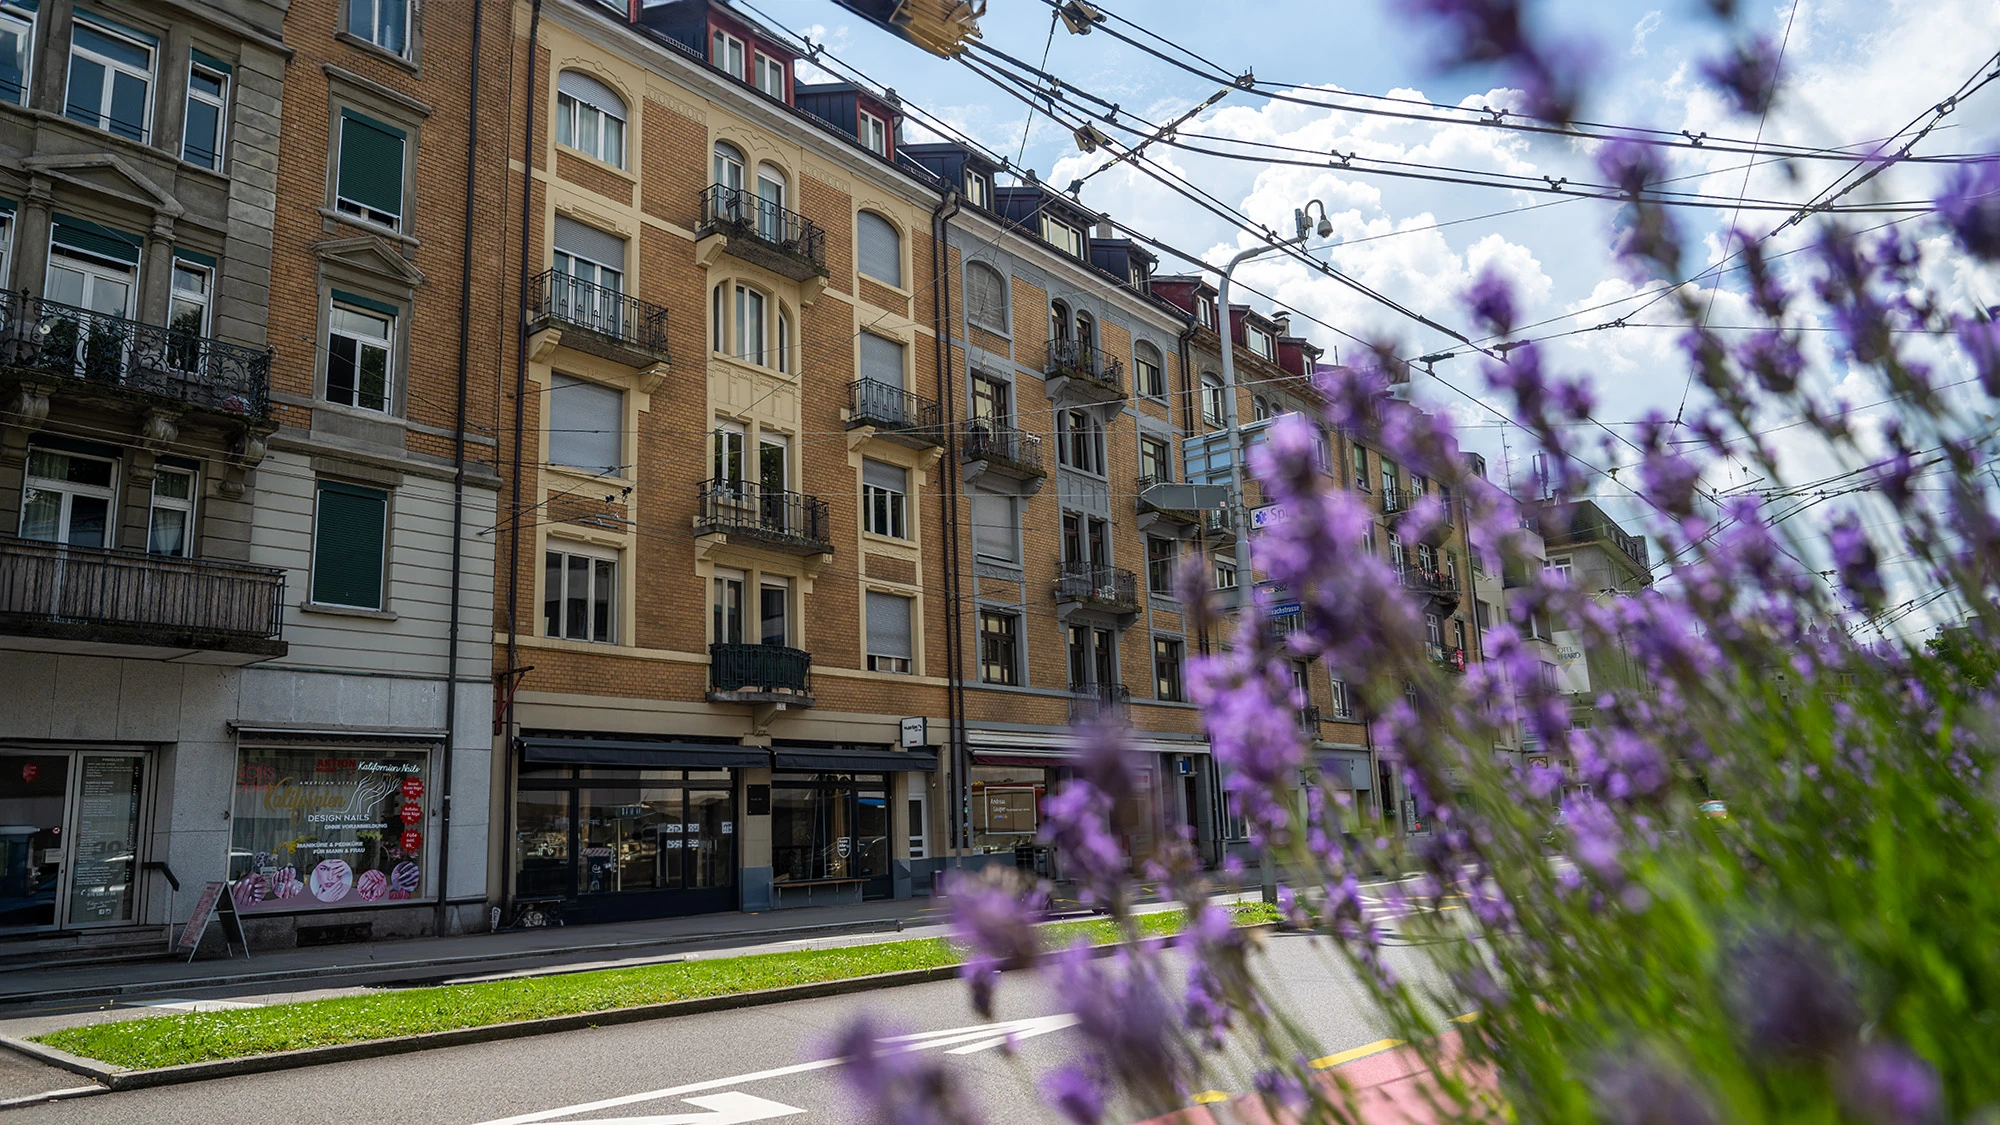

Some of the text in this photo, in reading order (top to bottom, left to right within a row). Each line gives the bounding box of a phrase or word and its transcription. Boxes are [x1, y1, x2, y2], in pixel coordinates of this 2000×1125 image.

[1270, 507, 1289, 522] Spi
[1557, 646, 1573, 654] OTEL
[316, 759, 356, 768] AKTION
[308, 813, 370, 822] DESIGN NAILS
[296, 841, 328, 849] MANIKÜRE
[312, 847, 325, 855] FÜR
